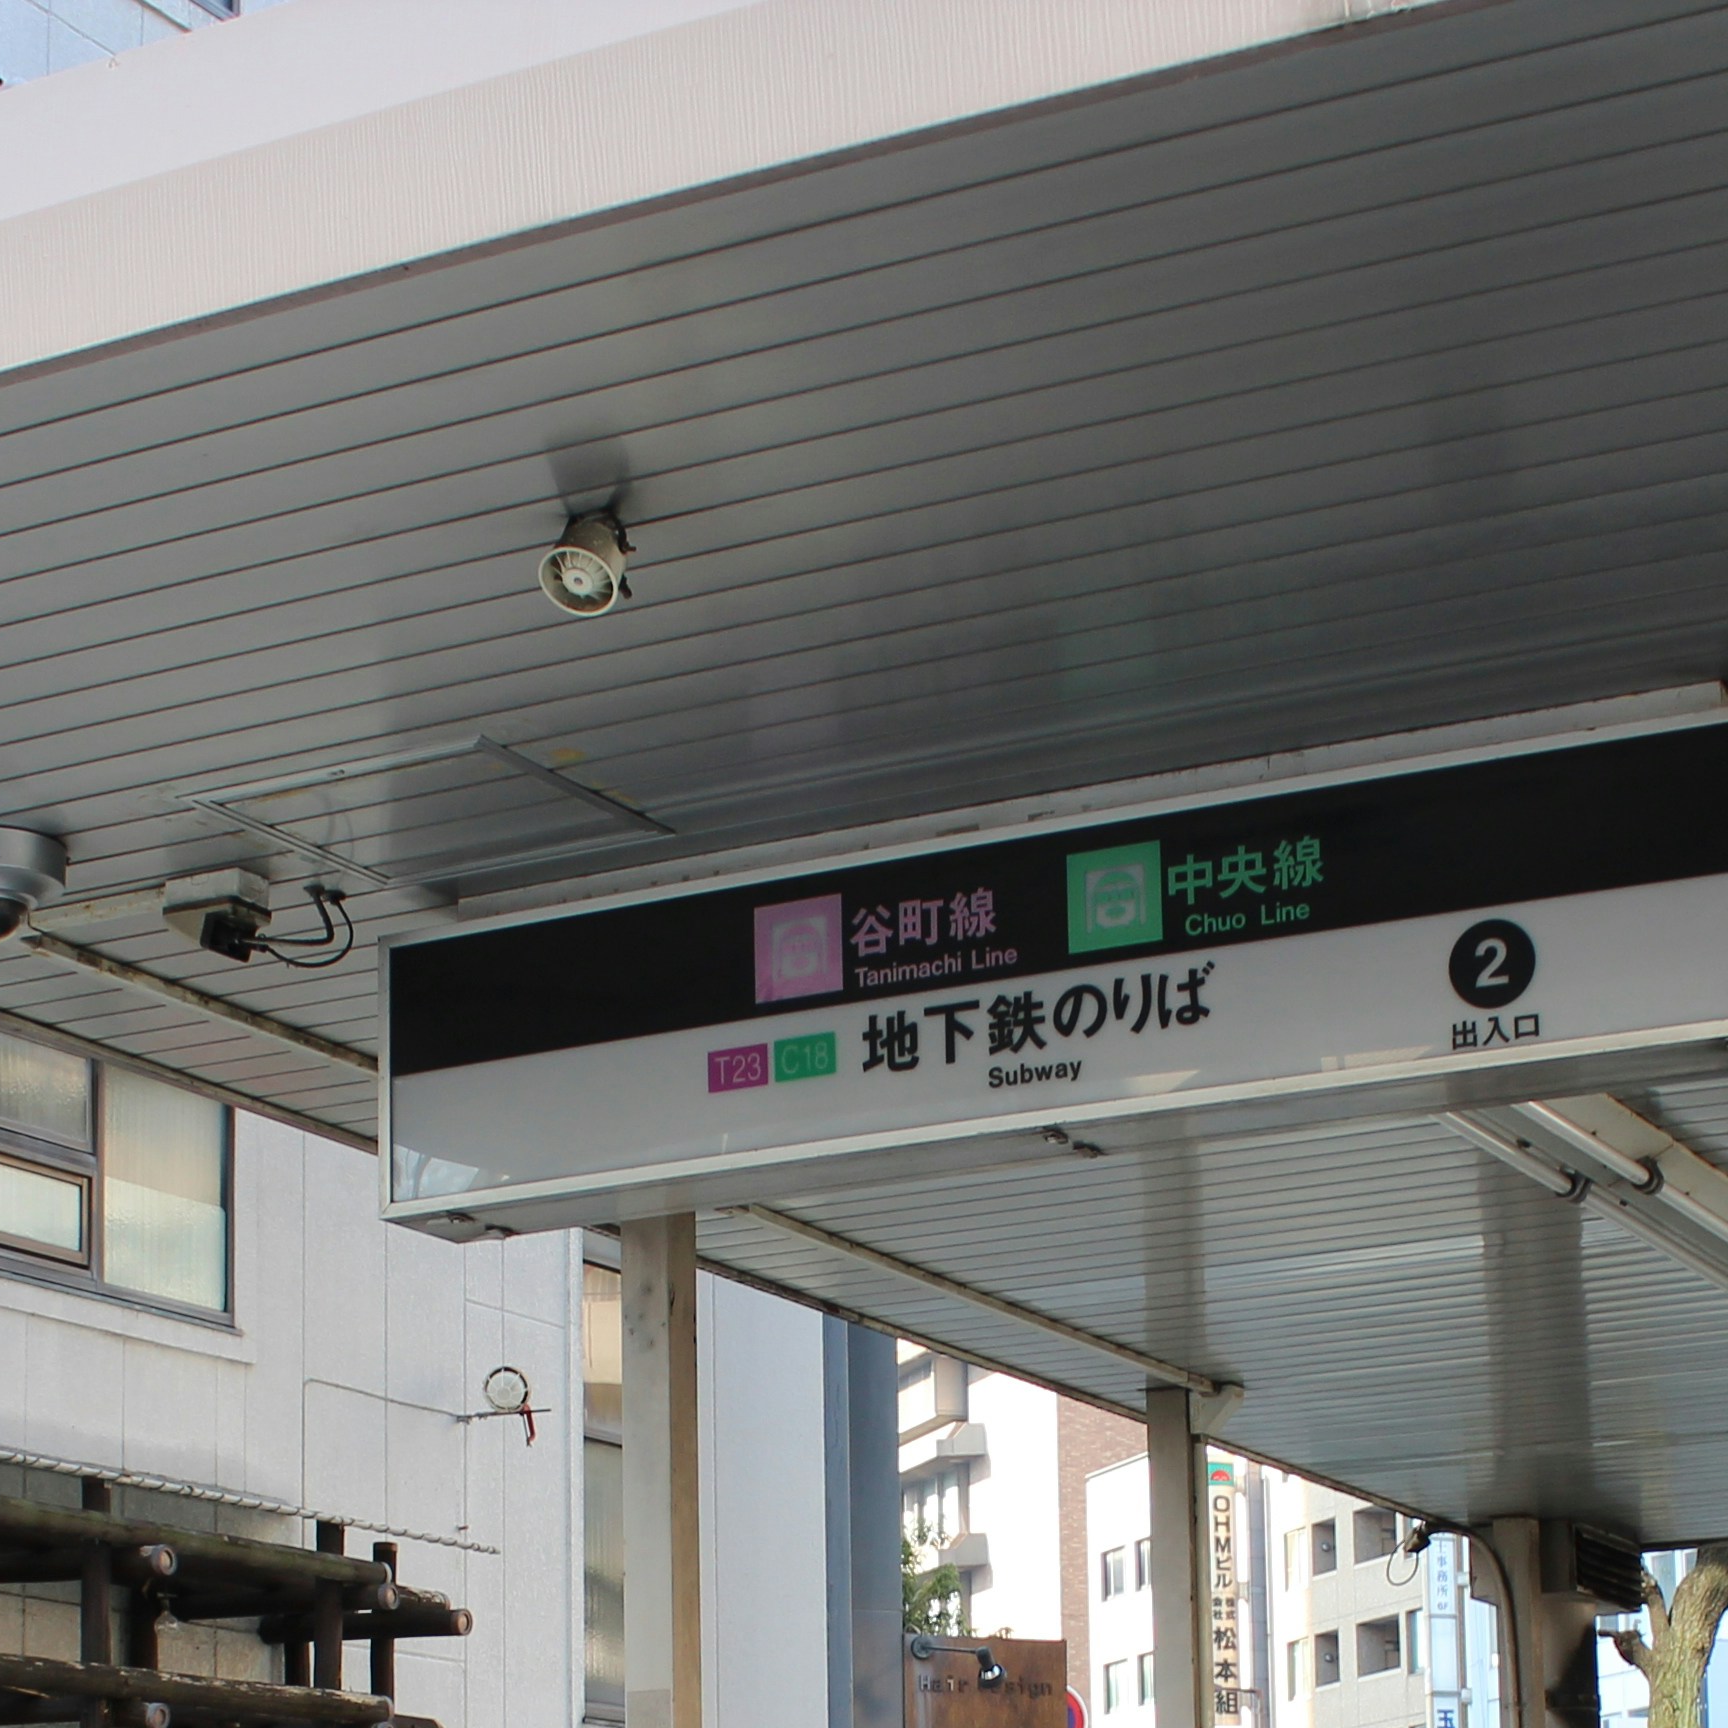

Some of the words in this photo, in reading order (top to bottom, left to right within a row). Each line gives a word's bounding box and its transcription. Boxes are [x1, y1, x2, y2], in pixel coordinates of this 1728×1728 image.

[1168, 835, 1324, 905] 中央線
[850, 887, 997, 958] 谷町線
[1184, 910, 1246, 937] Chuo
[1260, 900, 1311, 927] Line
[854, 954, 962, 988] Tanimachi
[971, 946, 1018, 972] Line
[1474, 937, 1509, 988] 2
[862, 961, 1215, 1074] 地下鉄のりば
[1452, 1013, 1540, 1050] 出入口
[715, 1052, 762, 1087] T23
[780, 1040, 829, 1074] C18
[988, 1057, 1082, 1089] Subway
[919, 1674, 969, 1693] Hair
[1214, 1626, 1238, 1715] 松本組
